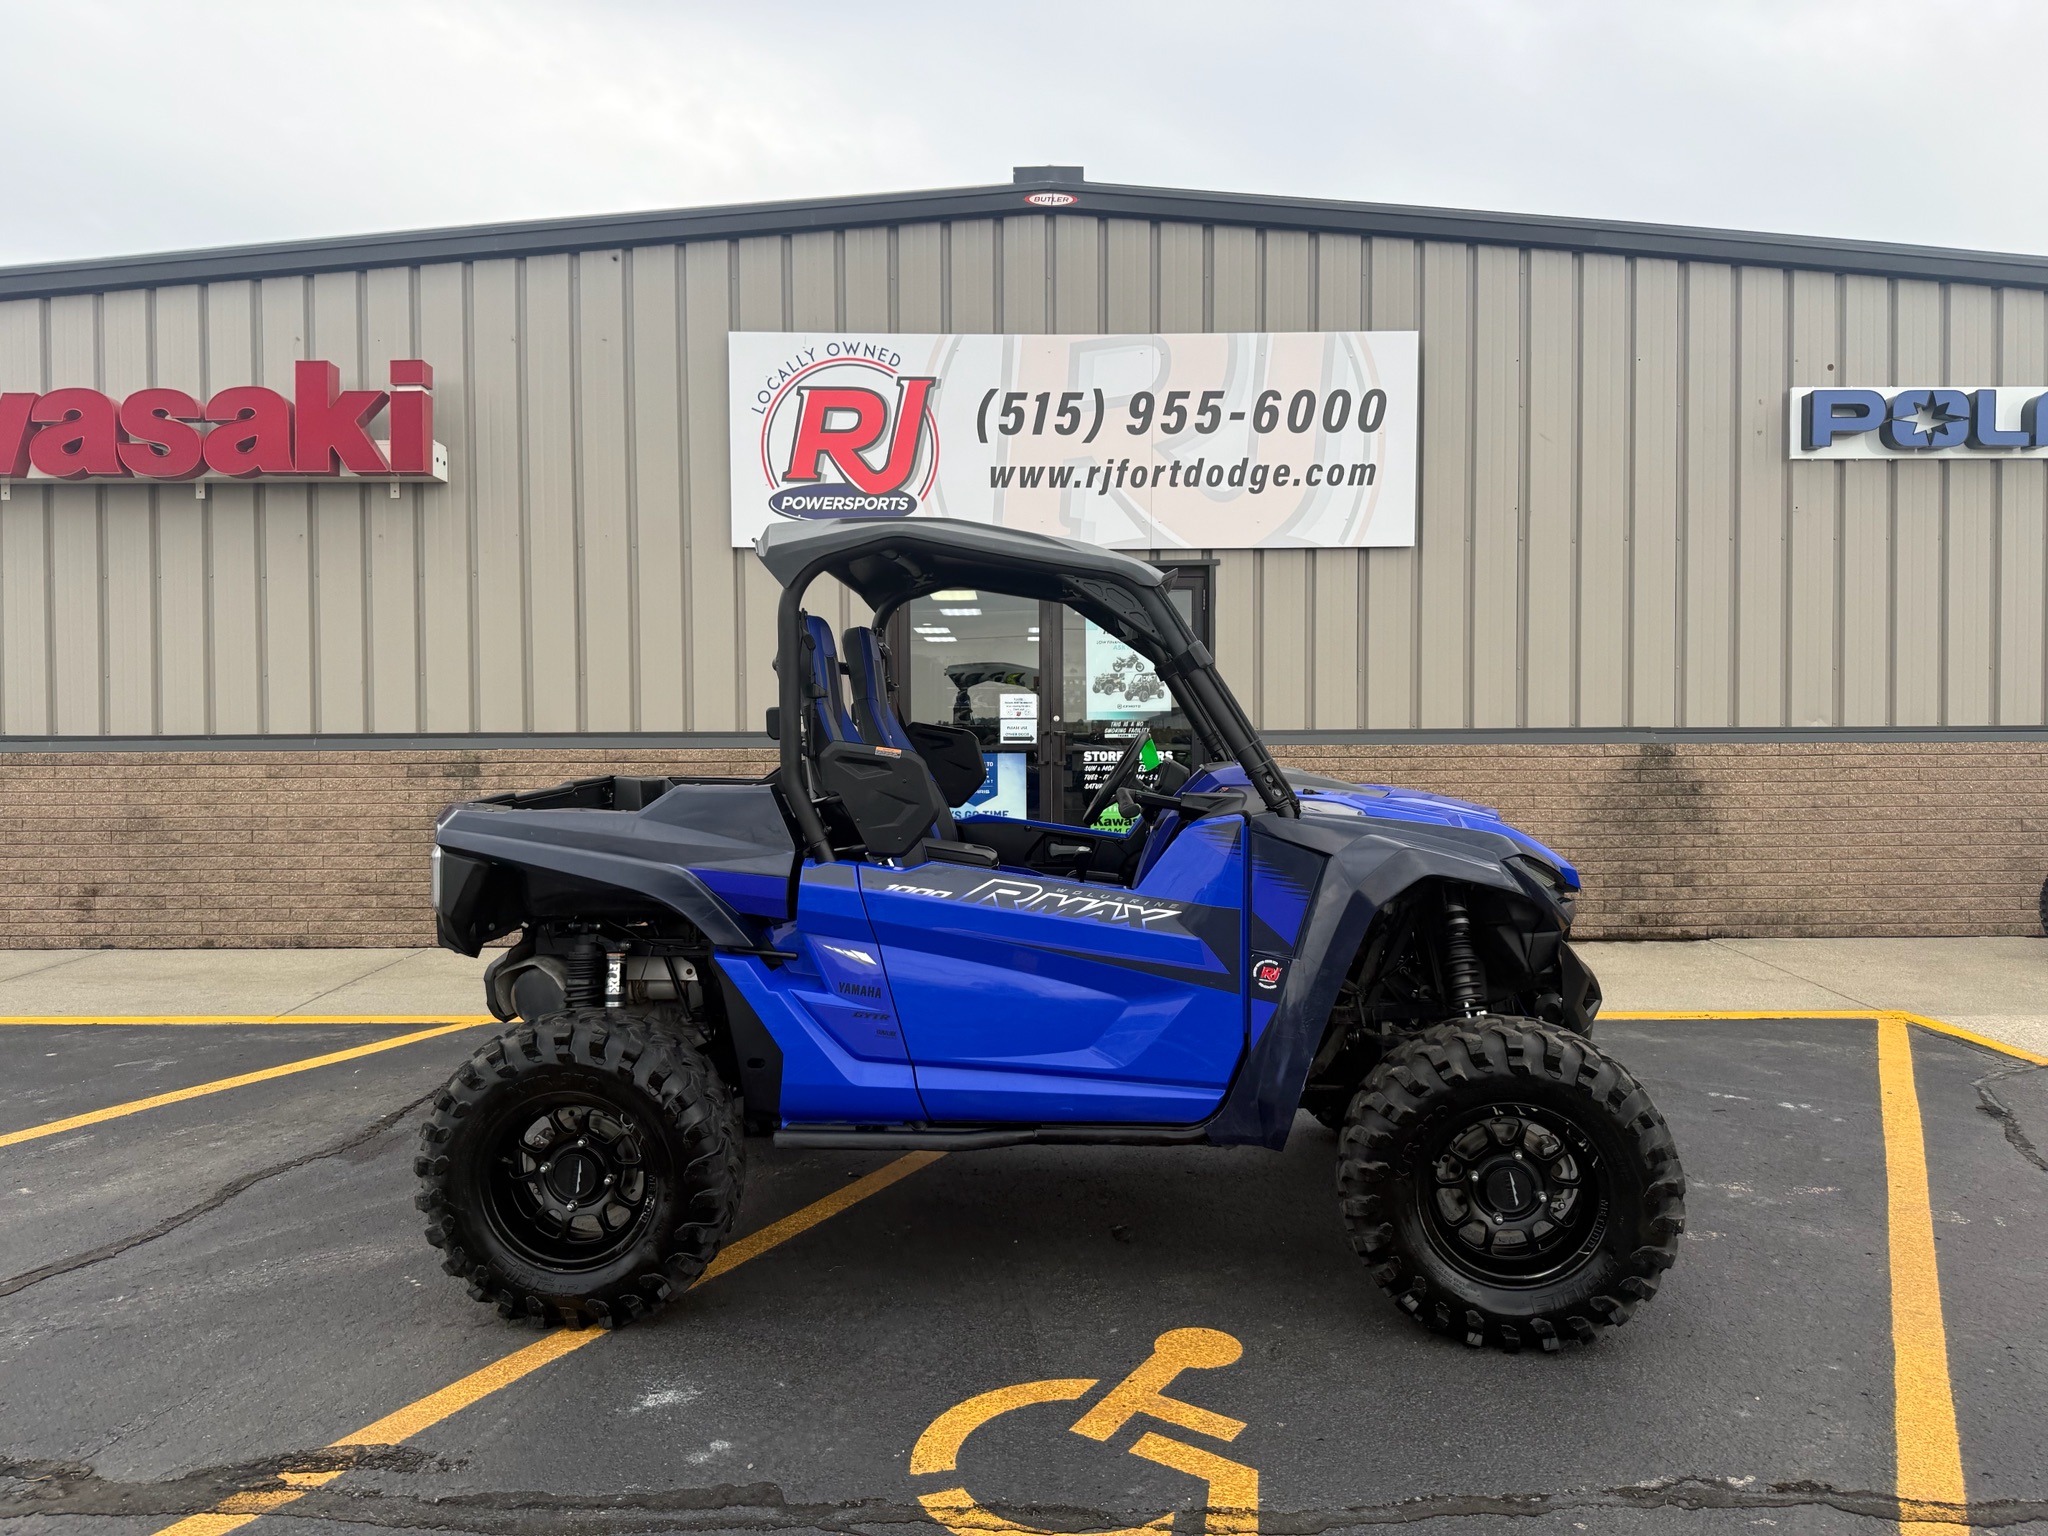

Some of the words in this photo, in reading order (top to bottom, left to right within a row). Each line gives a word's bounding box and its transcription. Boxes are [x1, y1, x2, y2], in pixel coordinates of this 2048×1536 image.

[751, 347, 816, 414] LOCALLY
[826, 341, 901, 367] OWNED
[781, 376, 942, 497] RJ
[976, 388, 1105, 444] (515)
[1126, 388, 1388, 436] 955-6000
[1801, 389, 2048, 450] POL
[989, 457, 1377, 496] www.rjfortdodge.com
[781, 496, 909, 511] POWERSPORTS
[838, 982, 882, 999] YAMAHA
[853, 1011, 890, 1020] GYTR
